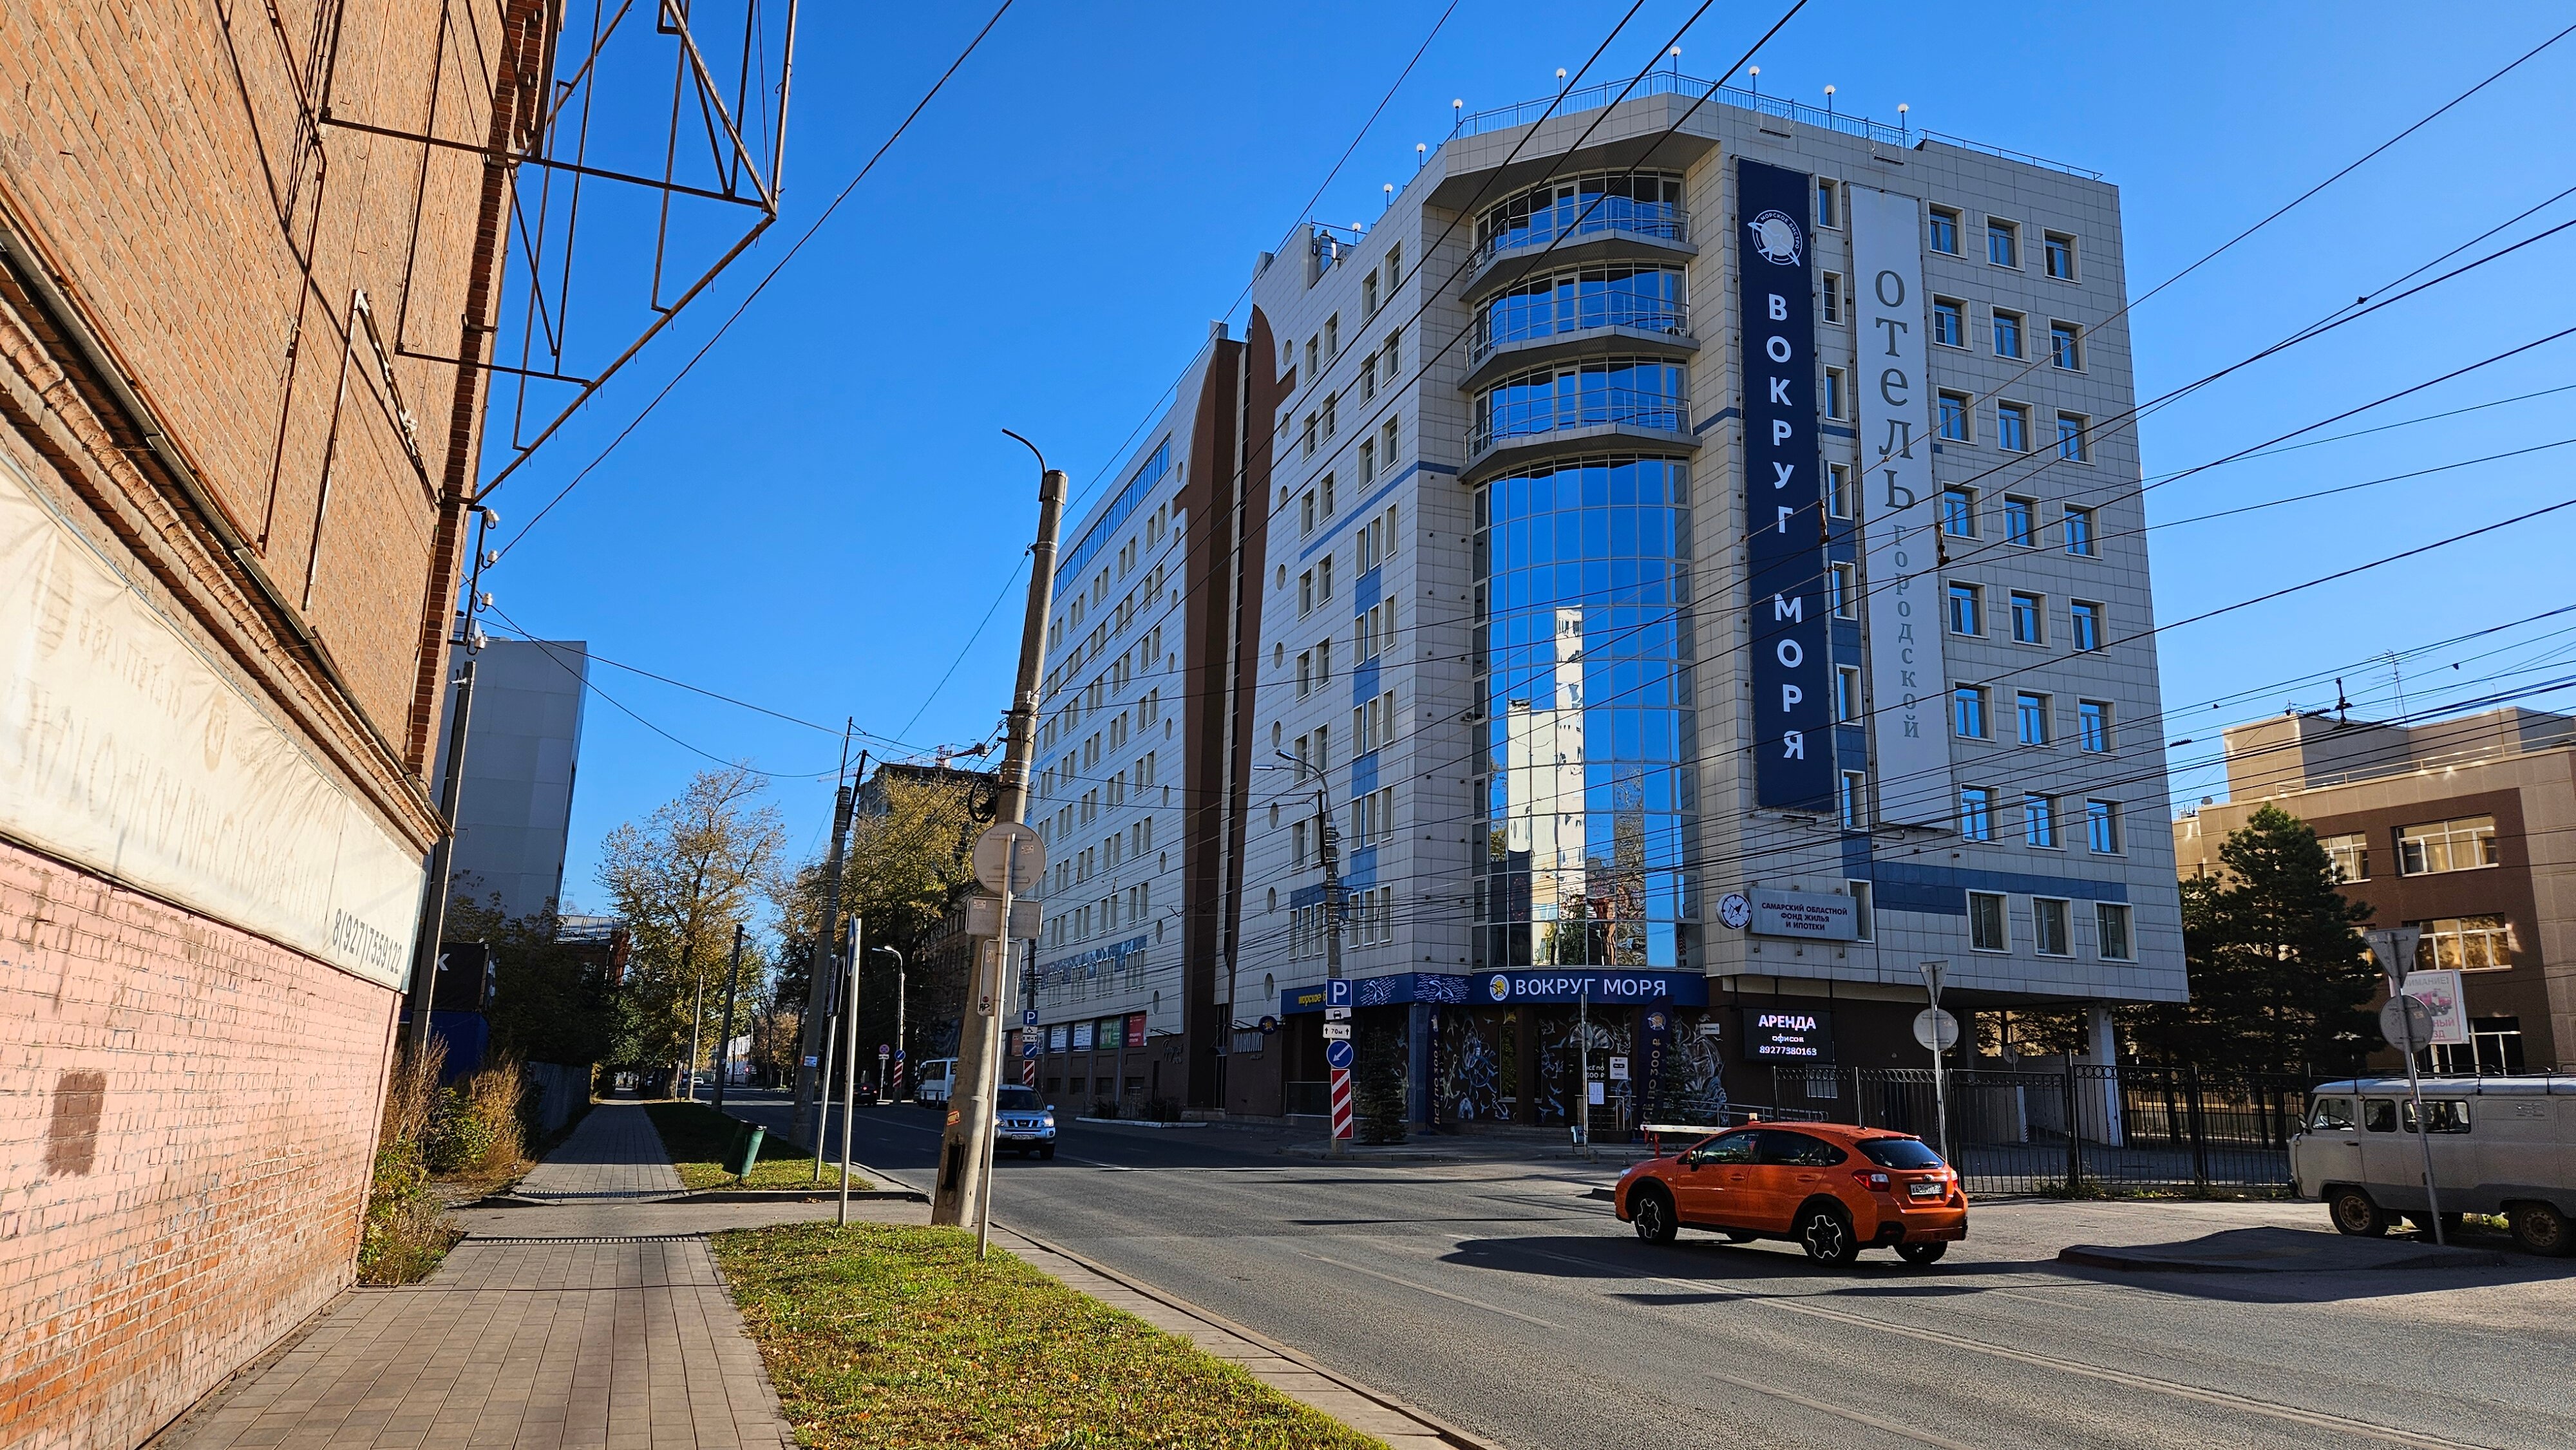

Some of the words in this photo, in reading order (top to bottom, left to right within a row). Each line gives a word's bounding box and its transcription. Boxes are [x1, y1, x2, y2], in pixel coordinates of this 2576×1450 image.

[1760, 212, 1788, 223] МОРСКОЕ
[1789, 223, 1800, 249] БИСТРО
[1766, 293, 1794, 534] ВОКРУГ
[1775, 593, 1804, 760] МОРЯ
[1761, 902, 1804, 912] САМАРСКИЙ
[1806, 906, 1848, 916] ОБЛАСТНОЙ
[1781, 912, 1803, 921] ФОНД
[1793, 922, 1825, 930] ИПОТЕКИ
[332, 908, 402, 974] 8(927)7559122
[1515, 978, 1596, 995] ВОКРУГ
[1604, 979, 1666, 996] МОРЯ
[1758, 1015, 1816, 1031] АРЕНДА
[1233, 1032, 1264, 1053] МОНОЛИТ
[1772, 1033, 1804, 1043] офисов
[1759, 1046, 1817, 1056] 89277380163
[1650, 1050, 1660, 1076] 300
